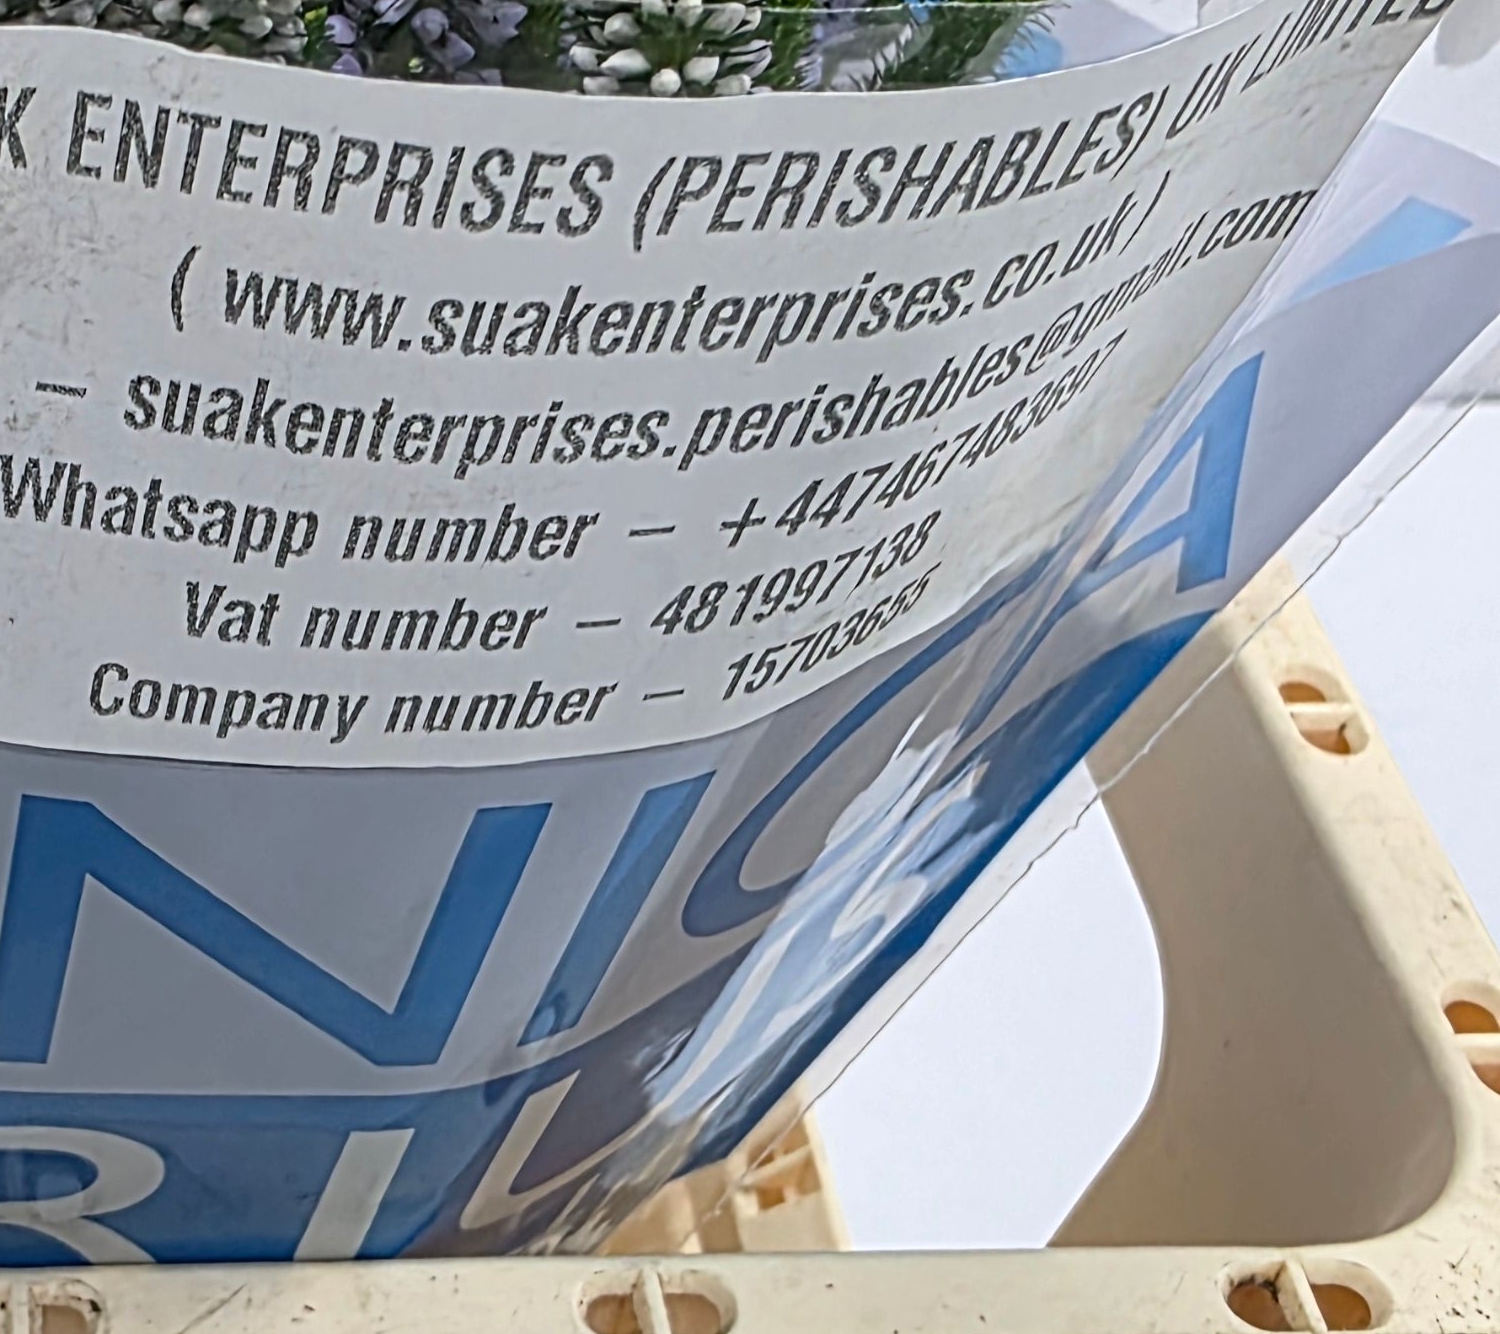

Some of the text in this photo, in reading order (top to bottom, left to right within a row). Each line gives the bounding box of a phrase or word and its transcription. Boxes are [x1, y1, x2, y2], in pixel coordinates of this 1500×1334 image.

[65, 91, 614, 239] ENTERPRISES
[631, 84, 1168, 253] (PERISHABLES)
[1165, 33, 1262, 141] UK
[0, 453, 319, 569] Whatsapp
[342, 502, 601, 565] number
[185, 580, 280, 648] Vat
[300, 595, 549, 653] number
[650, 509, 942, 638] 481997138
[89, 662, 369, 745] Company
[384, 679, 619, 735] number
[722, 562, 942, 701] 15703655
